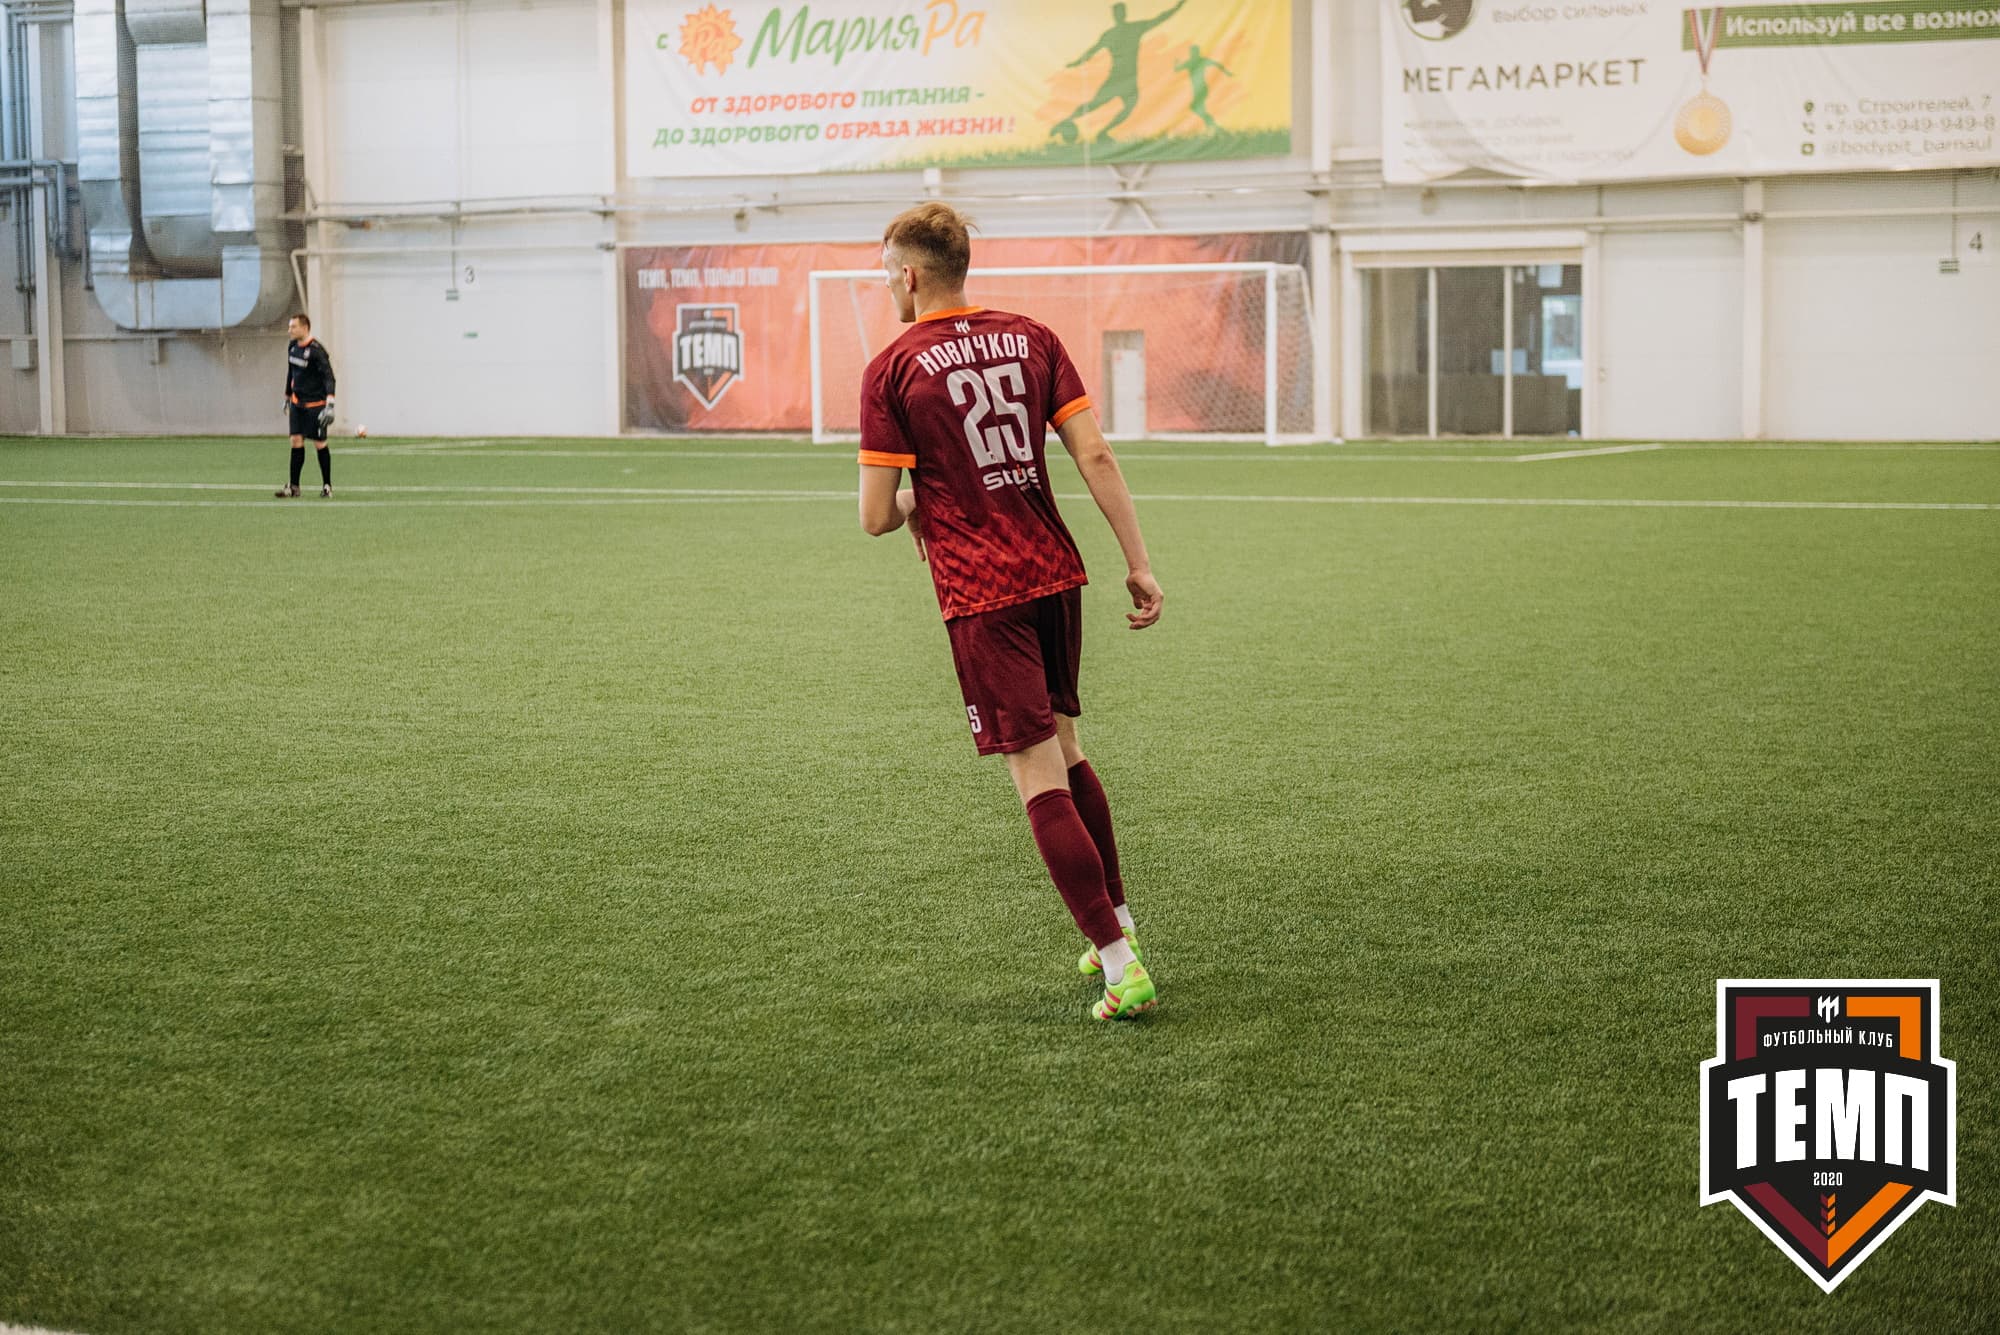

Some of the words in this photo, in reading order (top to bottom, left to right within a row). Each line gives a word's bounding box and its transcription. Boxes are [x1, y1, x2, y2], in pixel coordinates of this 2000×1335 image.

[1726, 12, 1857, 37] Используй
[1864, 13, 1907, 31] все
[1403, 58, 1647, 93] МЕГАМАРКЕТ
[690, 97, 719, 114] ОТ
[724, 91, 856, 116] ЗДОРОВОГО
[862, 86, 970, 107] ПИТАНИЯ
[653, 127, 684, 148] ДО
[689, 122, 820, 148] ЗДОРОВОГО
[825, 119, 909, 140] ОБРАЗА
[1968, 231, 1983, 252] 4
[464, 264, 475, 284] 3
[680, 332, 738, 371] ТЕМП
[916, 333, 1029, 376] НОВИЧКОВ
[946, 362, 1034, 468] 25
